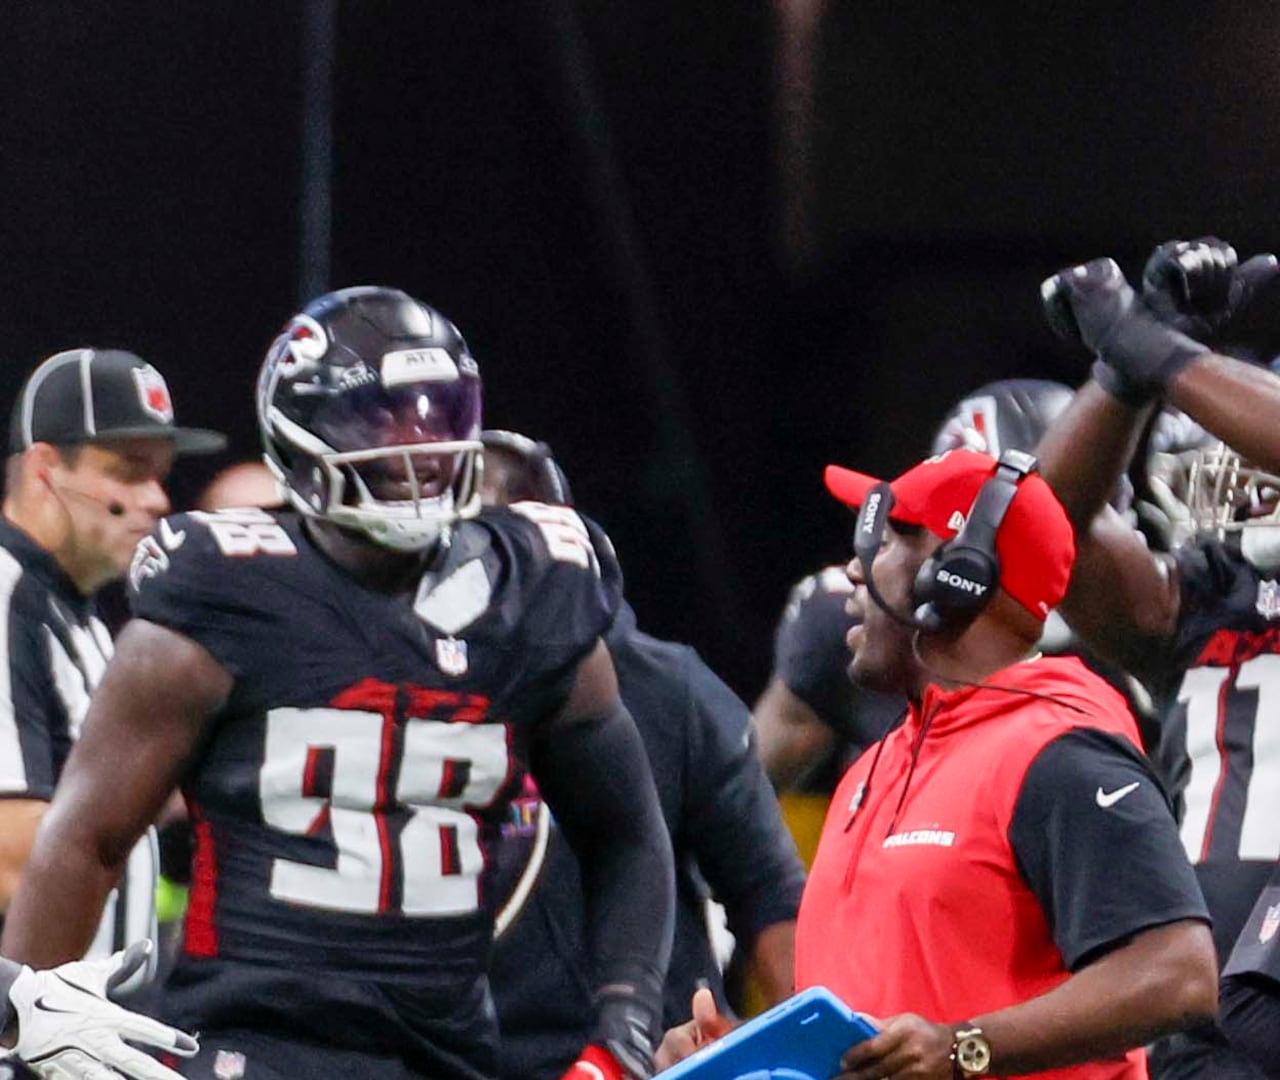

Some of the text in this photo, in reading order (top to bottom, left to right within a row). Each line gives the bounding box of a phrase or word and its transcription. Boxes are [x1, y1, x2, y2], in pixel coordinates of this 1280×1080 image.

[862, 493, 882, 534] SONY
[936, 569, 988, 597] SONY
[259, 706, 513, 917] 98
